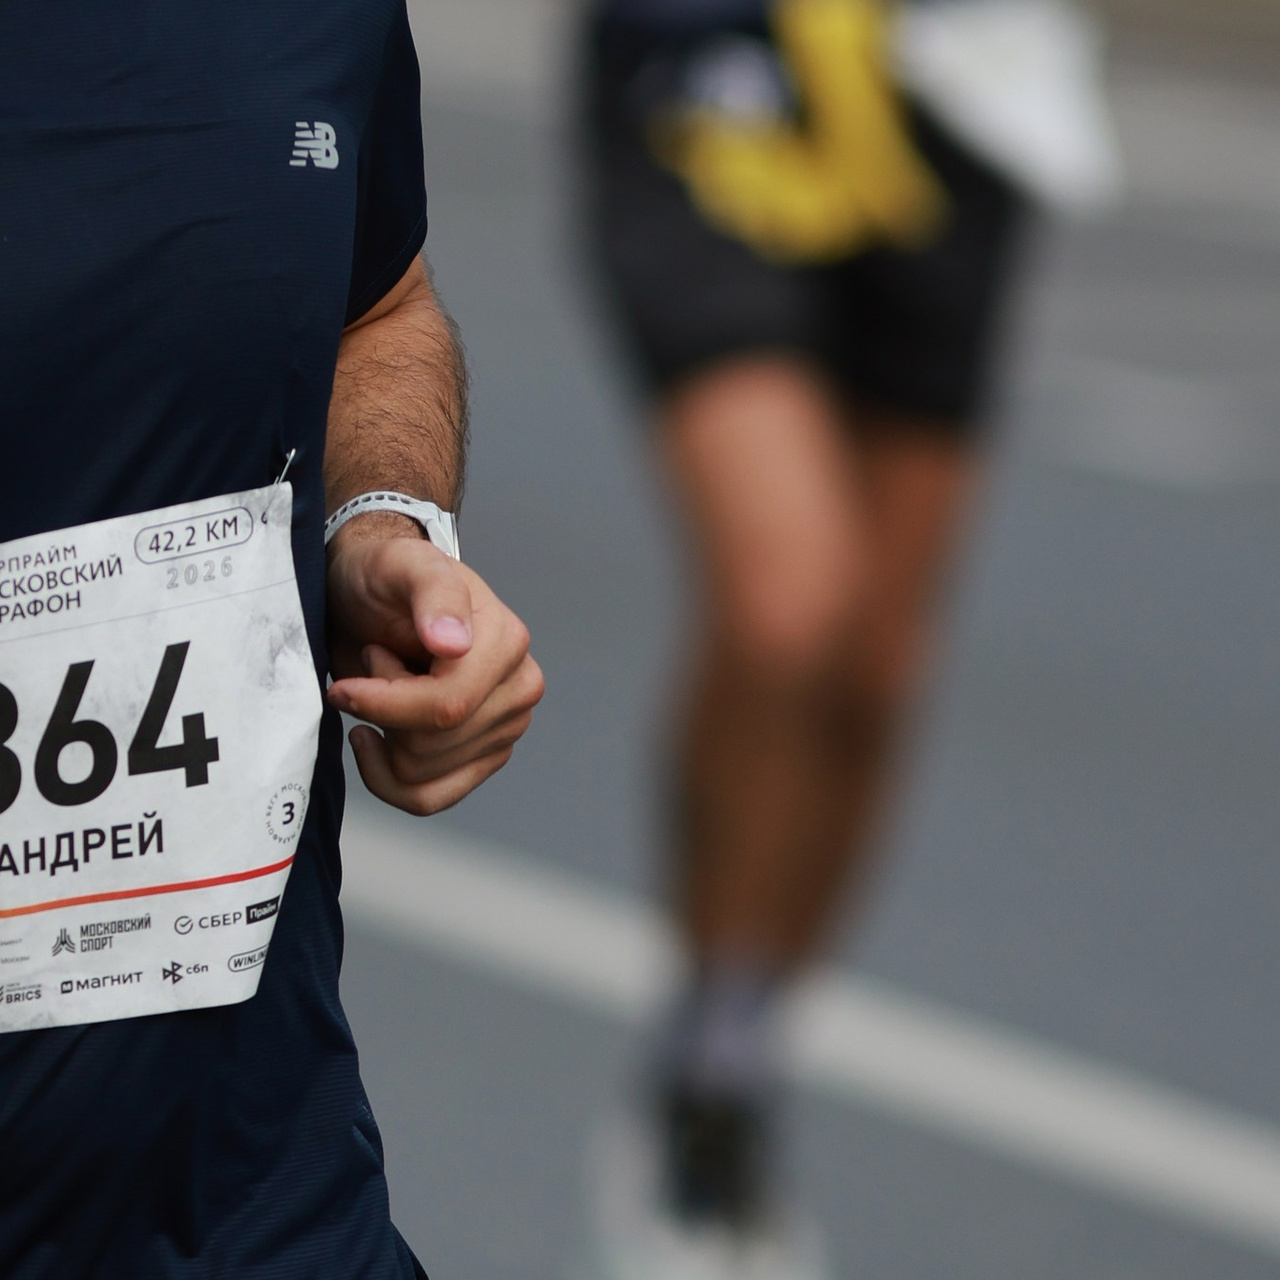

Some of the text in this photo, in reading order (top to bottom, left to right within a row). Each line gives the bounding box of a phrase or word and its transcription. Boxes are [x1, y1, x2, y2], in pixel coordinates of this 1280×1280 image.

[148, 515, 239, 554] 42,2 КМ
[166, 555, 234, 590] 2026
[282, 801, 295, 826] 3
[80, 912, 152, 938] МОСКОВСКИЙ
[198, 911, 243, 929] СБЕР
[80, 935, 114, 952] СПОРТ
[186, 963, 209, 974] сбп
[5, 989, 42, 1004] BRICS
